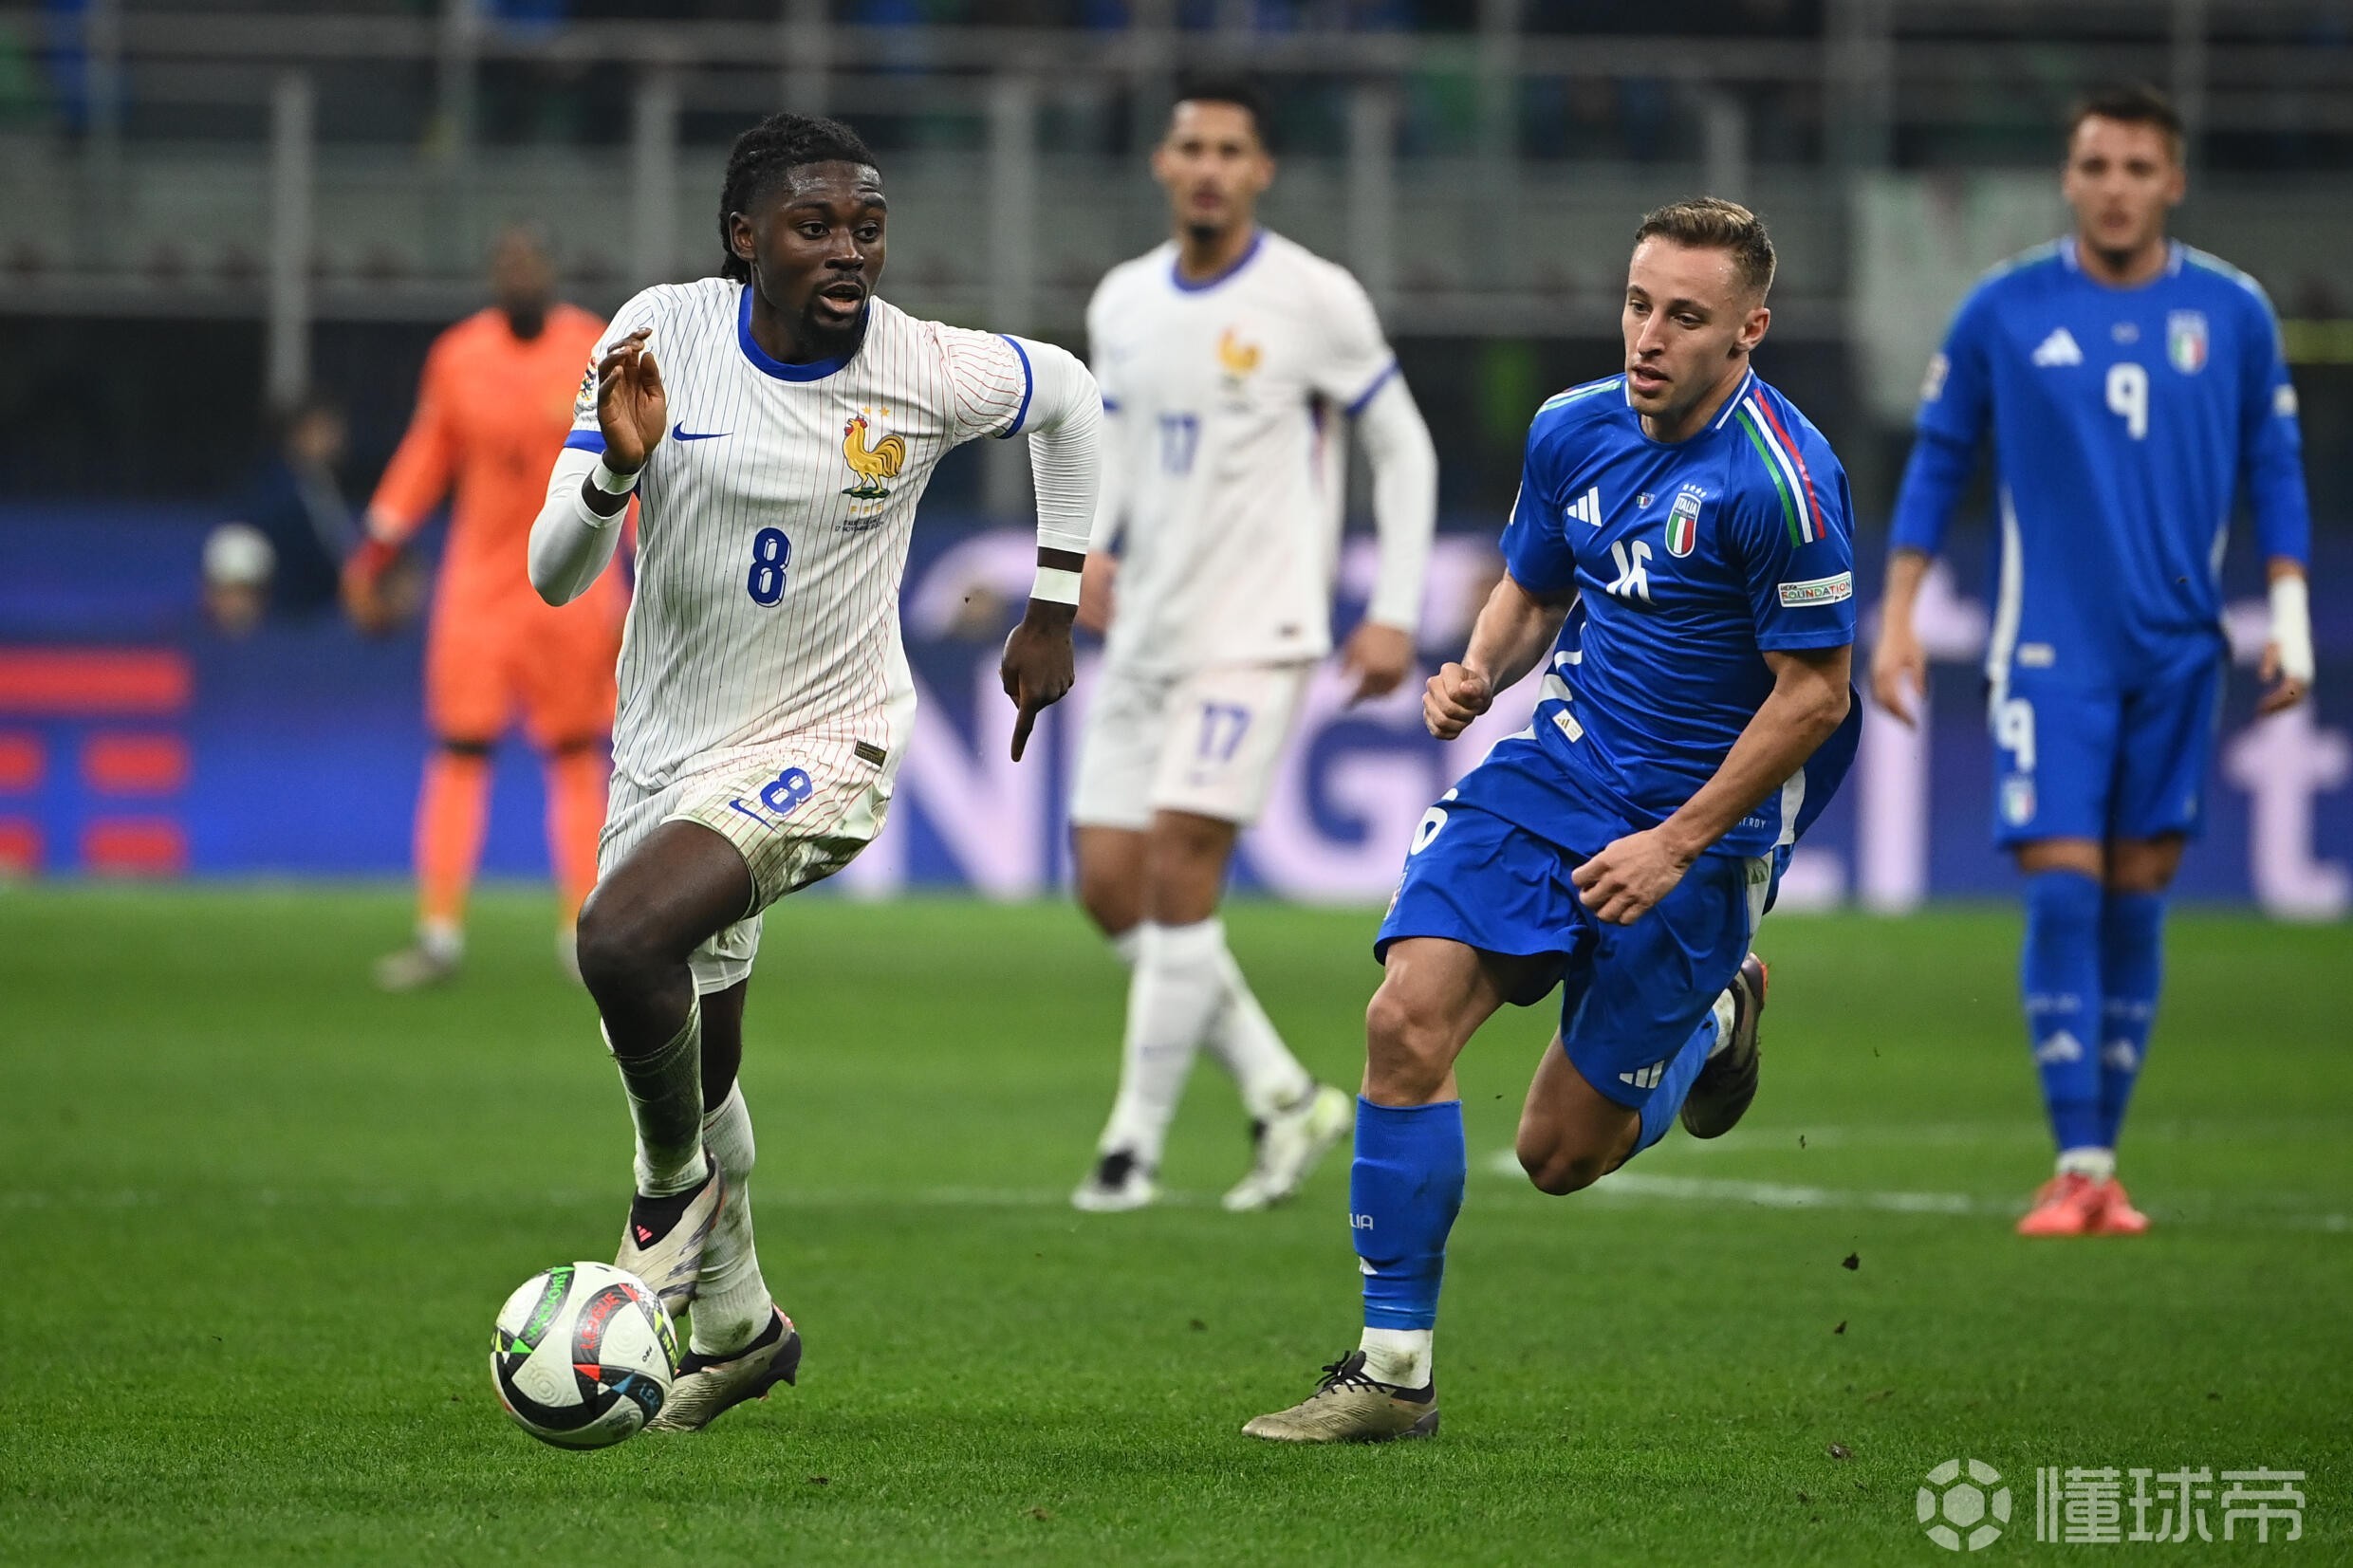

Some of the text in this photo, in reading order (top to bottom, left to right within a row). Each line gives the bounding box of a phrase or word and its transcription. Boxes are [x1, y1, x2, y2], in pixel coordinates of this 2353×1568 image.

[2107, 364, 2147, 439] 9
[1158, 414, 1200, 474] 17
[1676, 497, 1698, 516] ITALIA
[748, 527, 791, 608] 8
[1605, 540, 1658, 605] 16
[1781, 580, 1852, 600] FOUNDATION
[1200, 700, 1252, 762] 17
[1999, 699, 2036, 772] 9
[760, 767, 812, 818] 8
